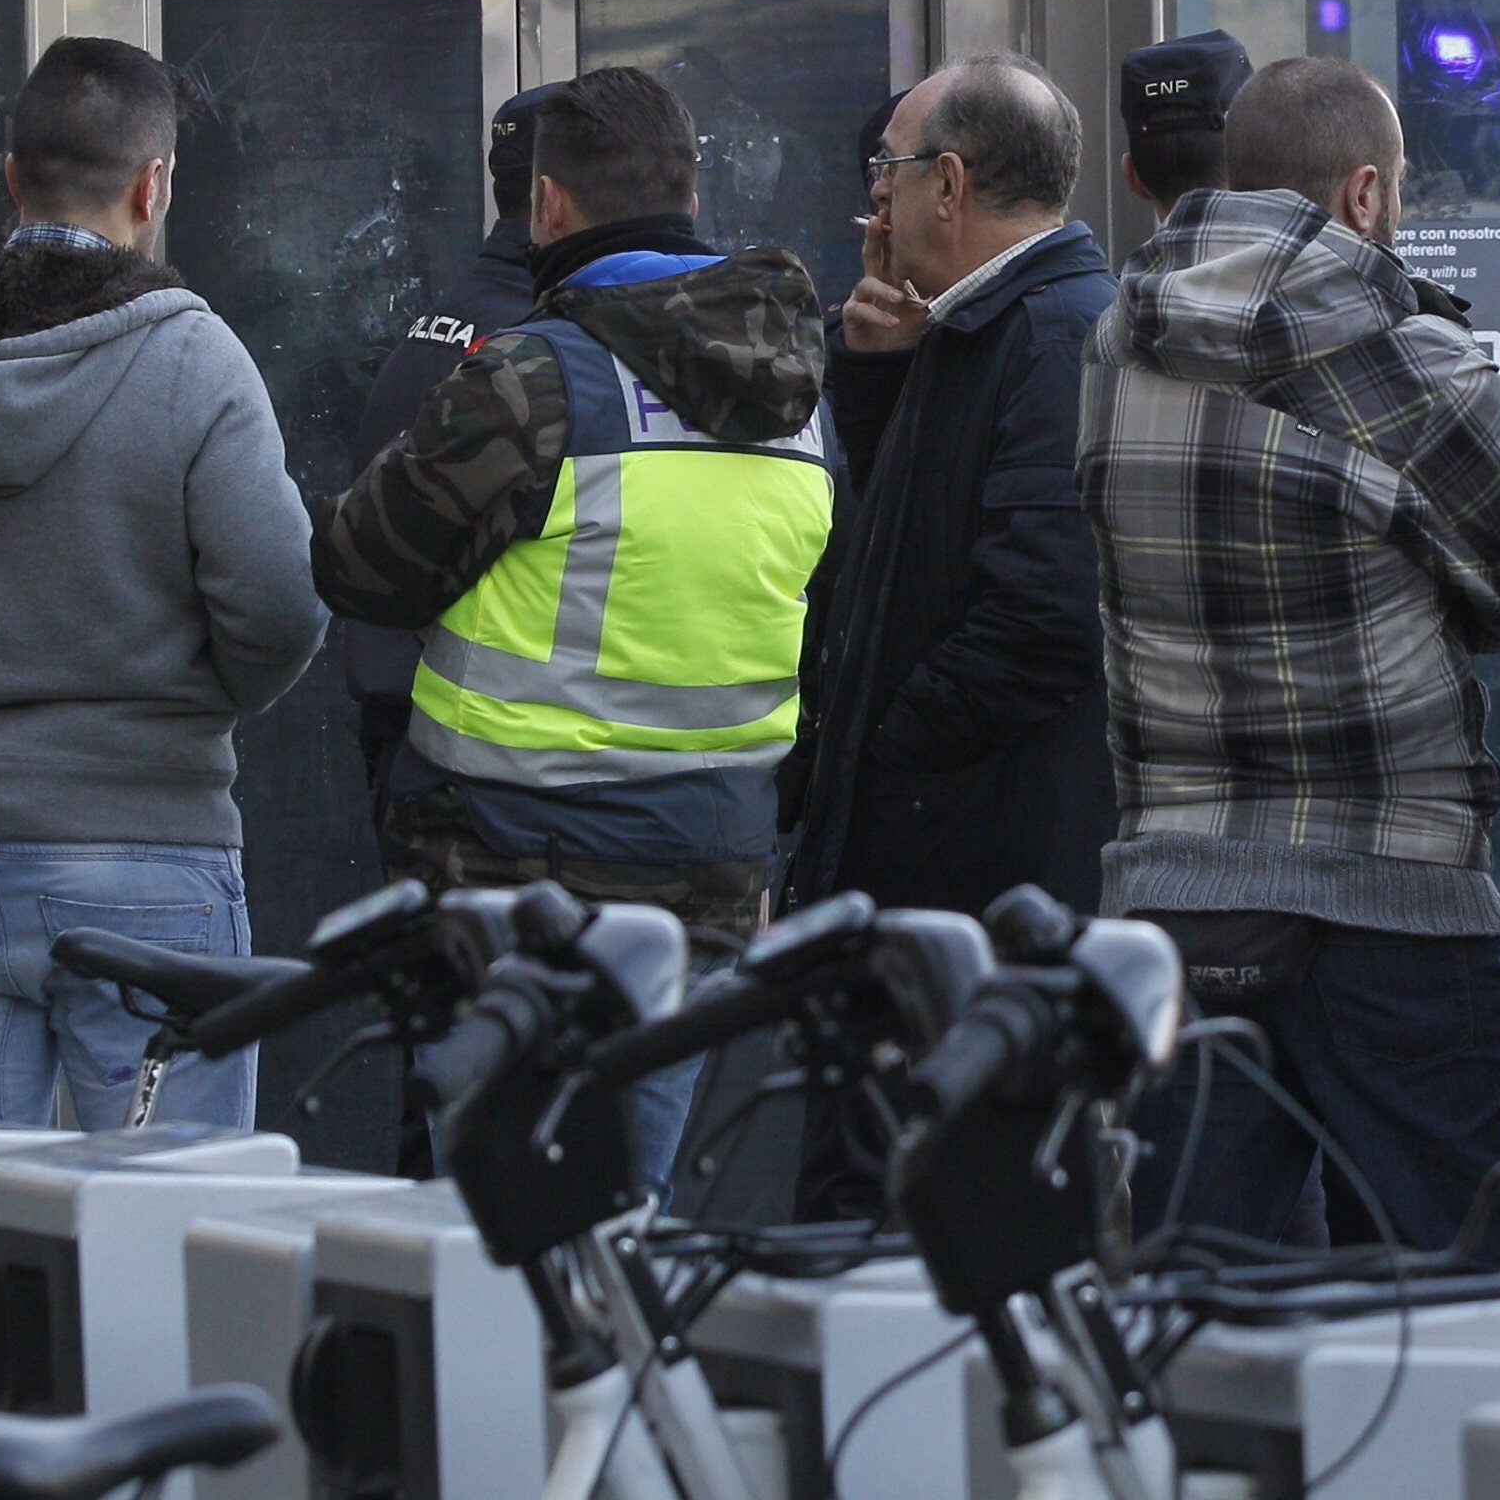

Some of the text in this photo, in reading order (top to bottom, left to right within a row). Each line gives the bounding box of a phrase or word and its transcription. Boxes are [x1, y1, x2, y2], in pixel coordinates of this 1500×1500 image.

[1145, 79, 1189, 97] CNP
[494, 122, 517, 135] NP
[1419, 229, 1445, 240] con
[1431, 264, 1458, 278] with
[1461, 266, 1477, 278] us
[407, 315, 475, 348] OLICIA
